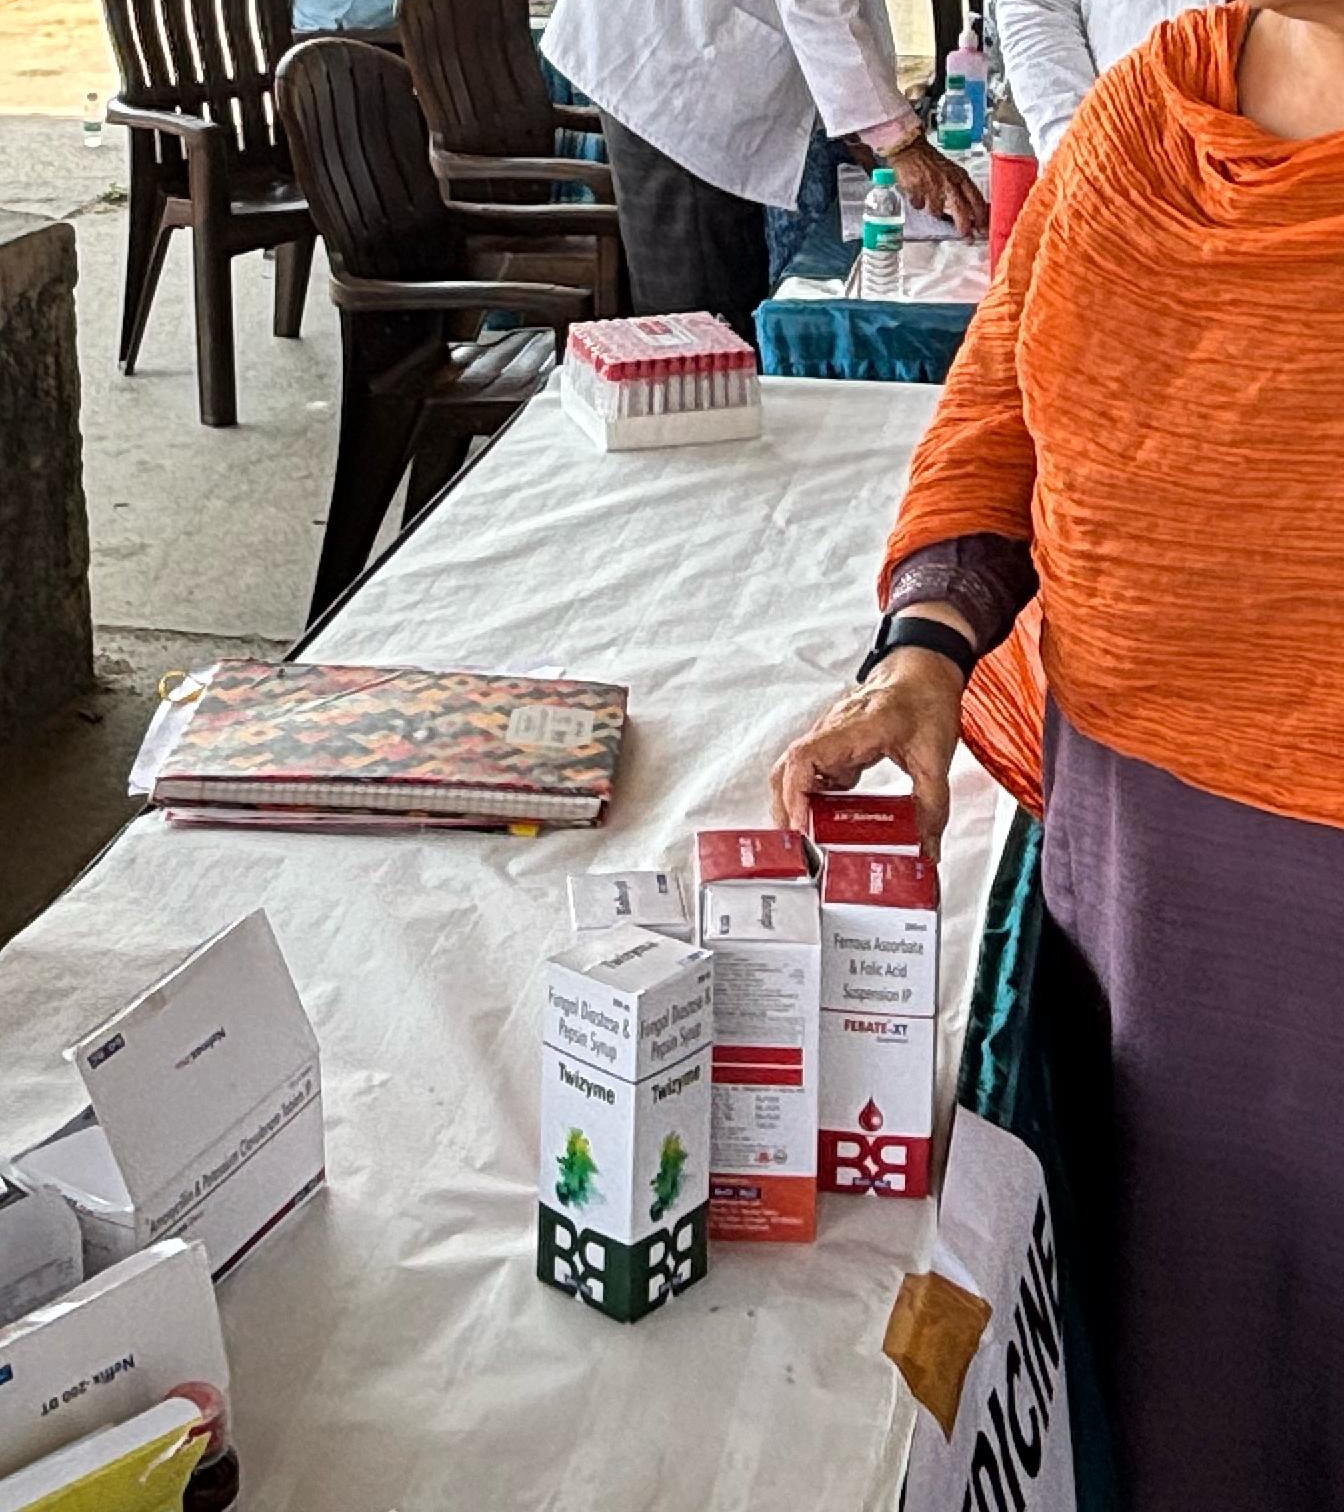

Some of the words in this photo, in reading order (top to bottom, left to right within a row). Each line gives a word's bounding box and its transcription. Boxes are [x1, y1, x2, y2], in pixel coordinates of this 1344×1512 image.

[834, 932, 871, 952] Ferrous
[874, 936, 924, 956] Ascorbate
[850, 958, 858, 975] &
[861, 960, 883, 977] Folic
[885, 961, 908, 978] Acid
[549, 985, 579, 1017] Fungal
[622, 1018, 630, 1039] &
[843, 982, 900, 1003] Suspension
[559, 1016, 588, 1046] Pepsin
[590, 1031, 617, 1063] Syrup
[559, 1061, 616, 1105] Twizyme
[652, 1064, 701, 1104] Twizyme
[961, 1192, 1061, 1512] DICINE
